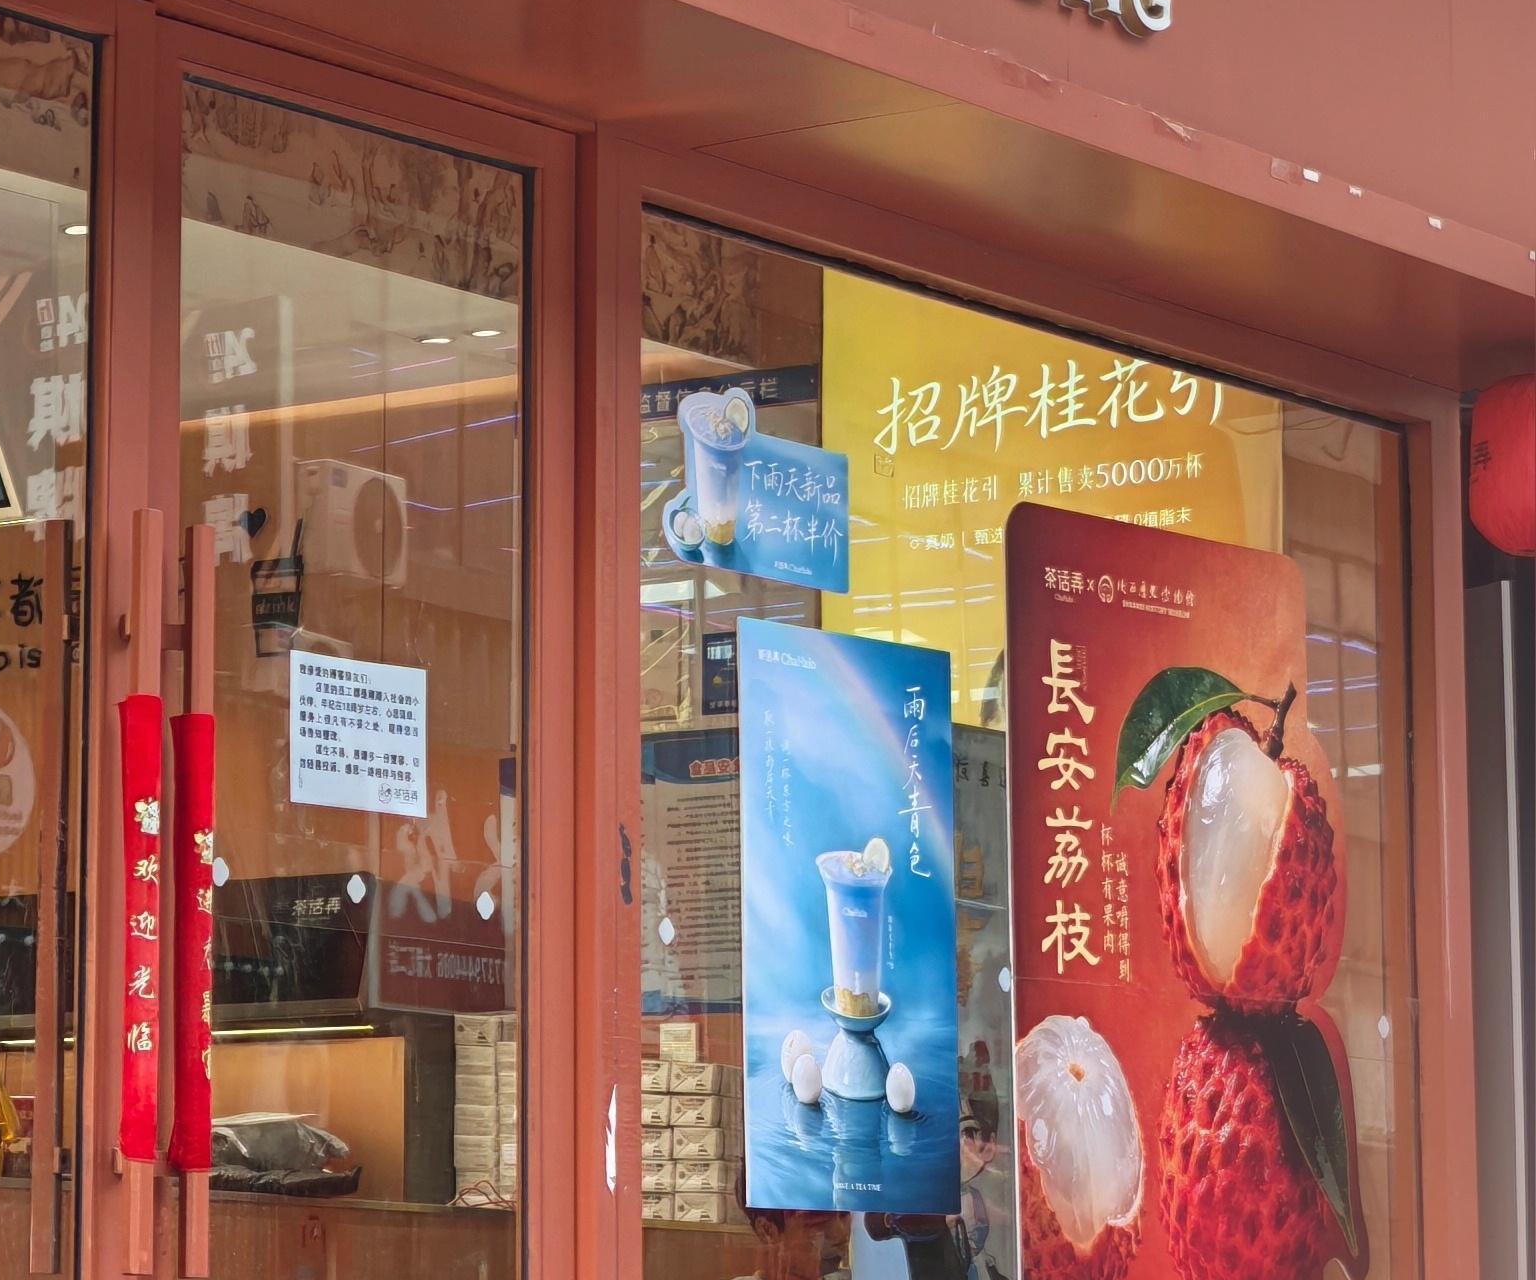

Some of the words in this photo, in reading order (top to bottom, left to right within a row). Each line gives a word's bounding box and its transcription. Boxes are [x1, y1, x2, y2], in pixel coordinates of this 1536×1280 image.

[874, 359, 1225, 456] 招牌桂花引
[744, 460, 841, 512] 下雨天新品
[902, 474, 998, 510] 招牌桂花引
[743, 498, 843, 567] 第二杯半价
[1044, 567, 1084, 595] 茶话弄
[18, 643, 42, 670] is
[898, 686, 933, 878] 雨后天青色
[1101, 823, 1116, 955] 杯杯有果肉
[127, 857, 161, 1054] 欢迎光临
